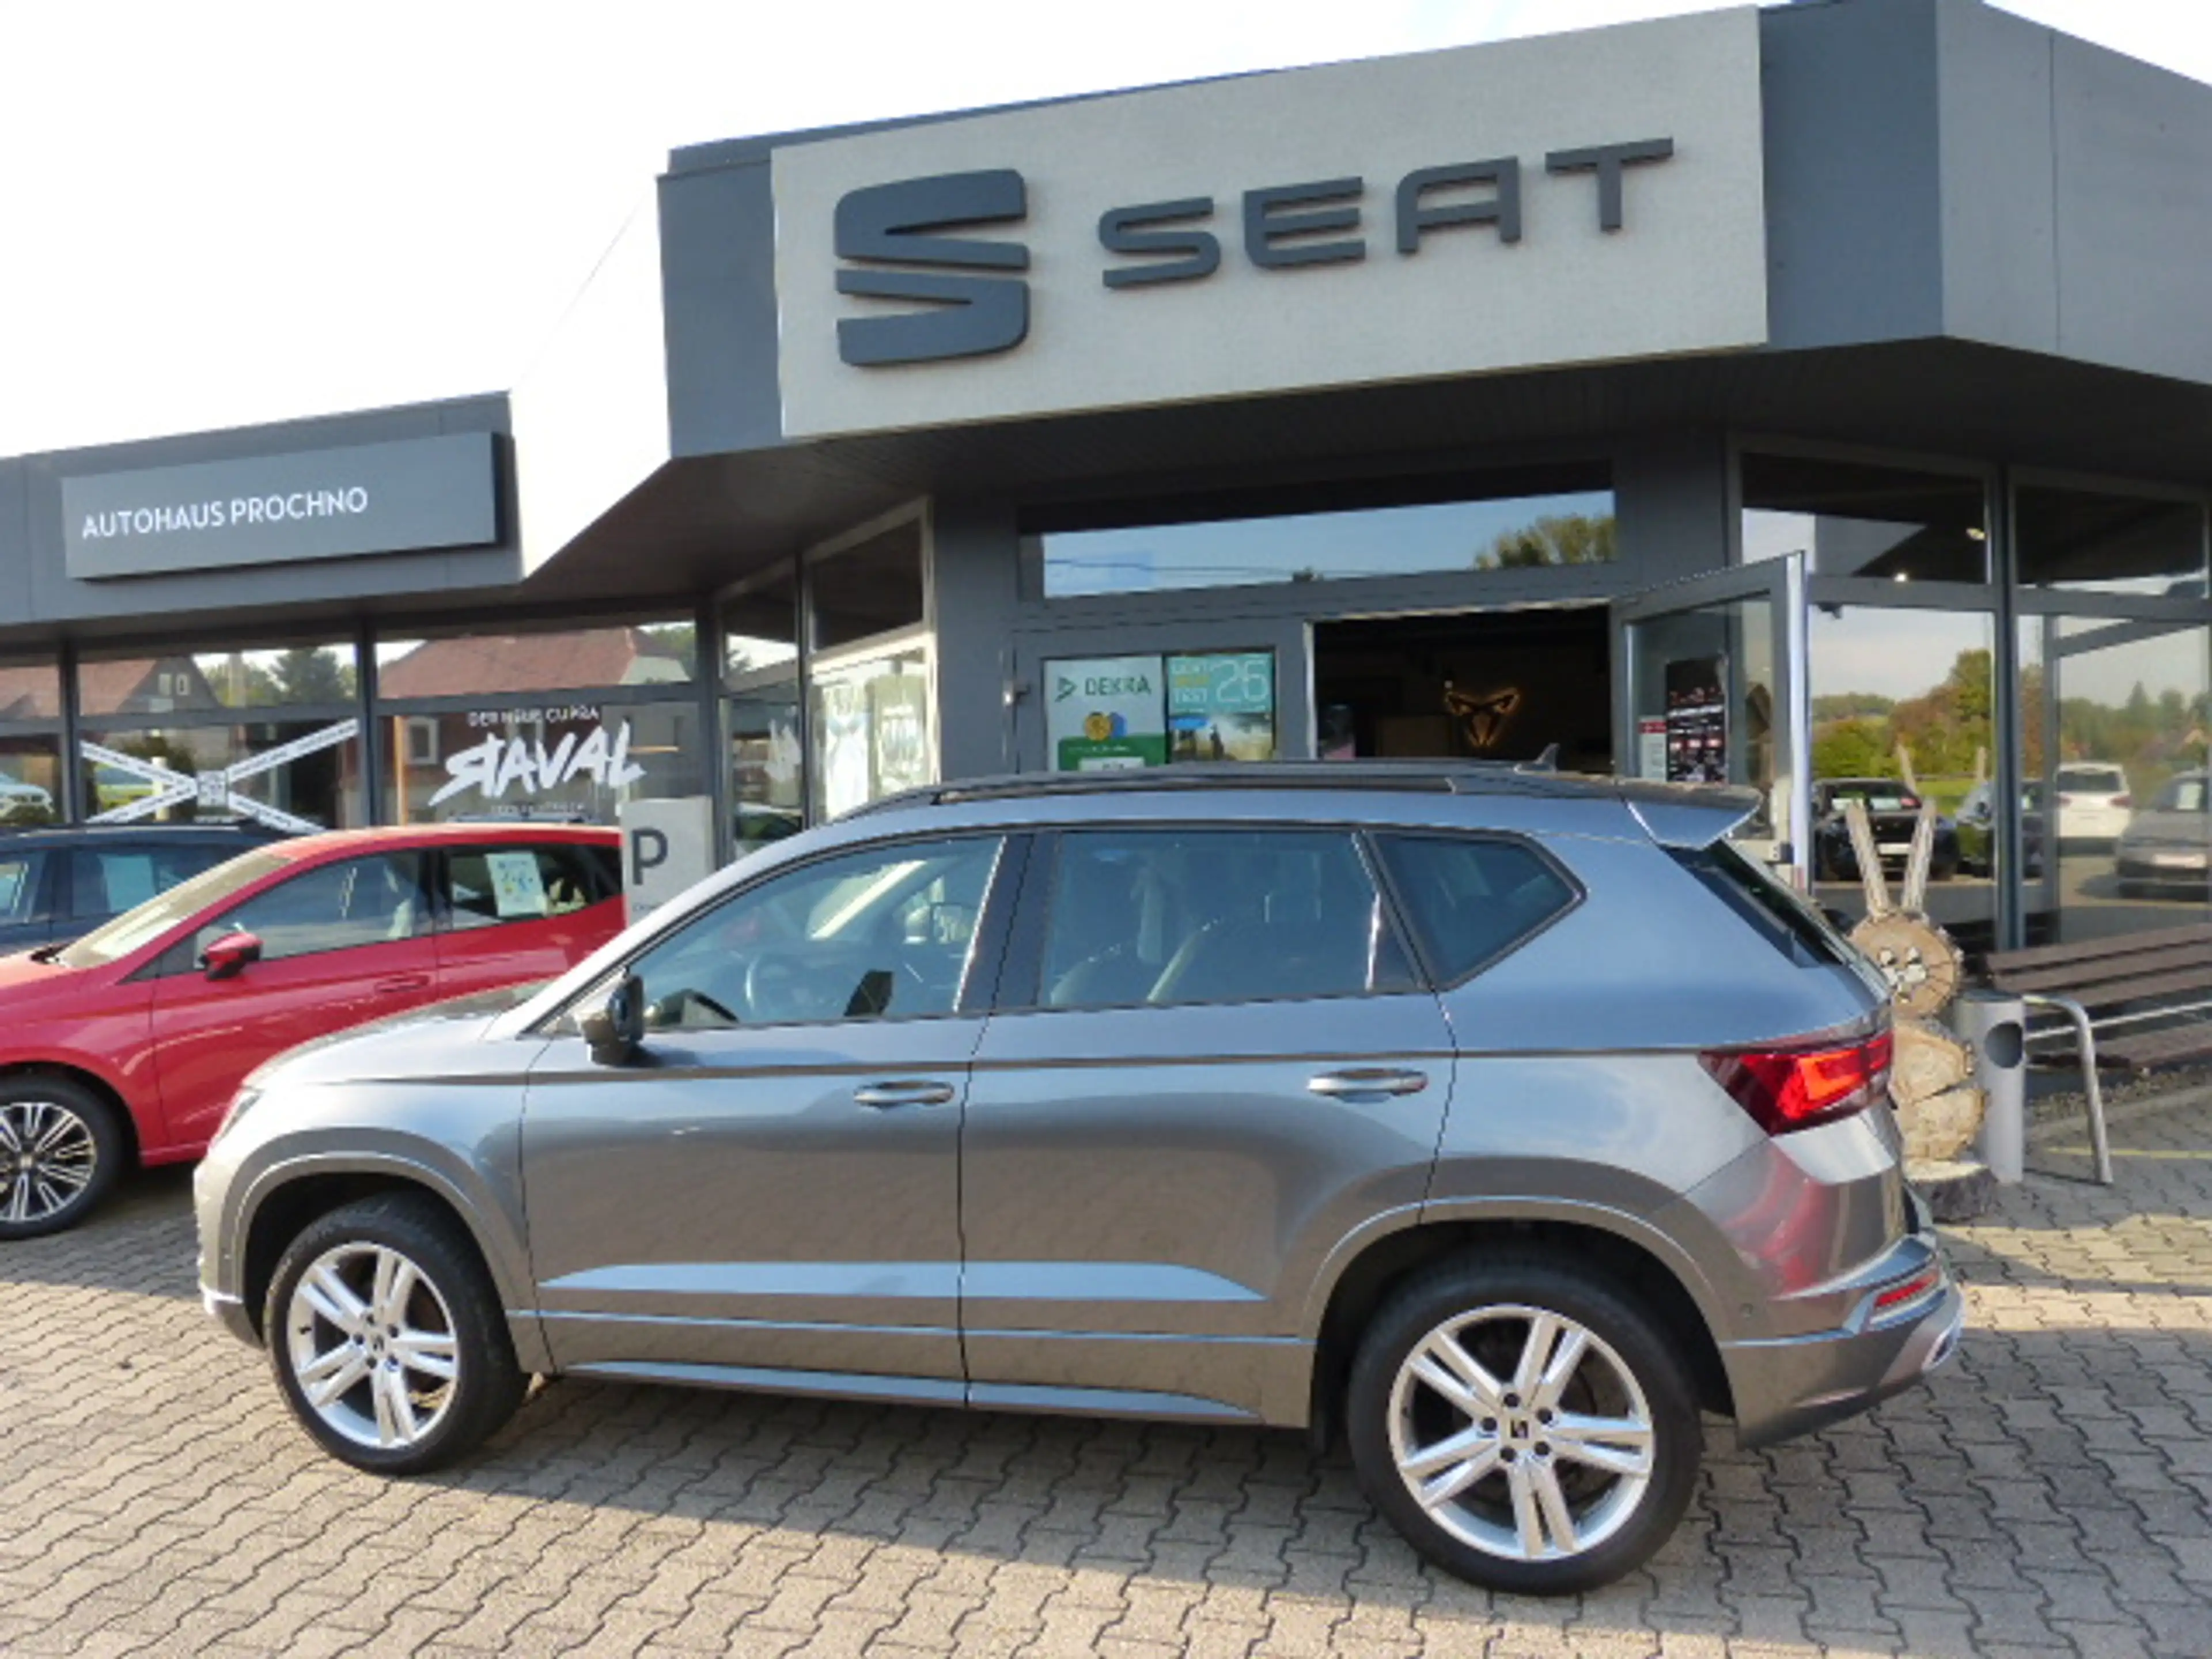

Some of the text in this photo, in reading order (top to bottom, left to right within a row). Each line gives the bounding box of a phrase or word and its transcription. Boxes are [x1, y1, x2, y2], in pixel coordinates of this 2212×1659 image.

[1097, 137, 1675, 292] SEAT
[81, 486, 368, 540] AUTOHAUS PROCHNO
[1084, 675, 1153, 696] DEKRA
[631, 827, 669, 886] P
